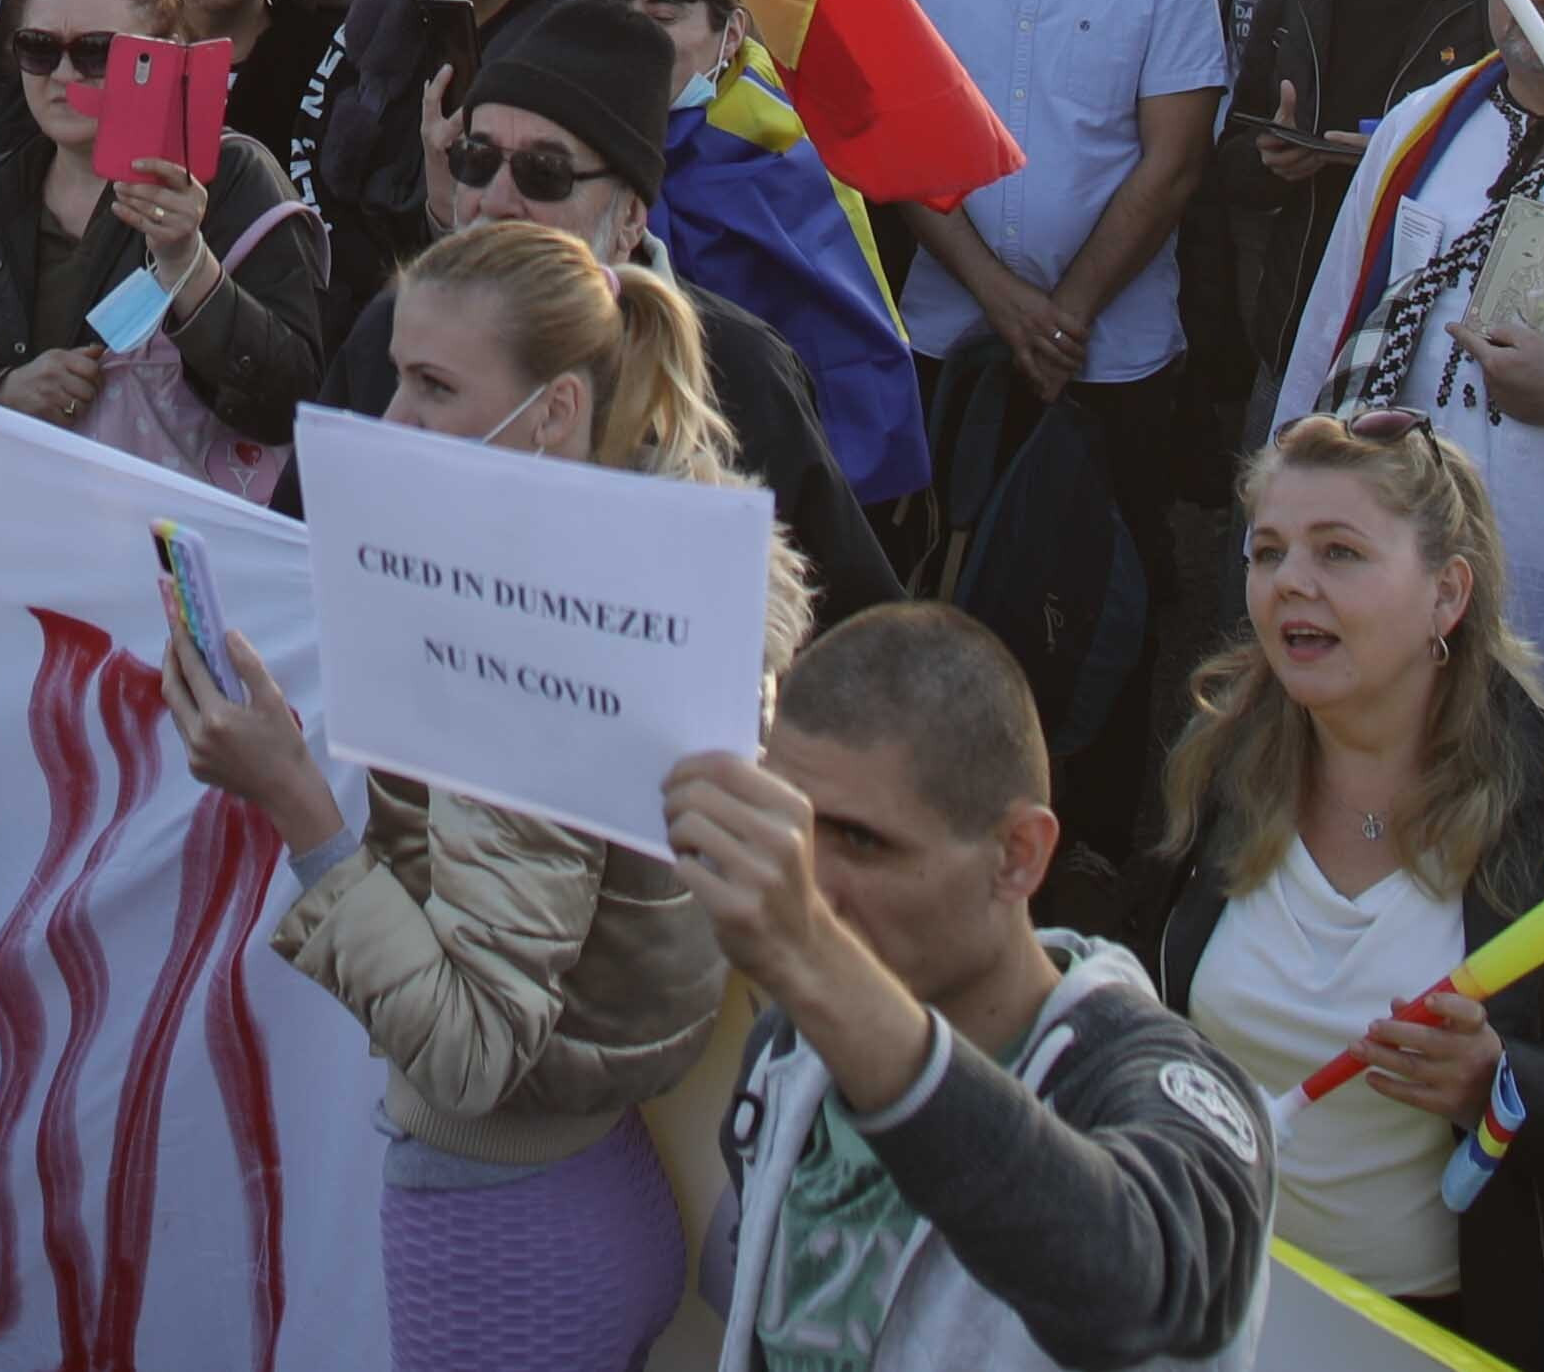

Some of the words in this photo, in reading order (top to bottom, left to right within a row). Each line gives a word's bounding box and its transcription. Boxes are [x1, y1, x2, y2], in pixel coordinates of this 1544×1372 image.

[357, 542, 442, 589] CRED
[450, 566, 486, 600] IN
[493, 577, 691, 647] DUMNEZEU
[423, 636, 468, 672] NU
[476, 650, 510, 685] IN
[514, 664, 622, 717] COVID
